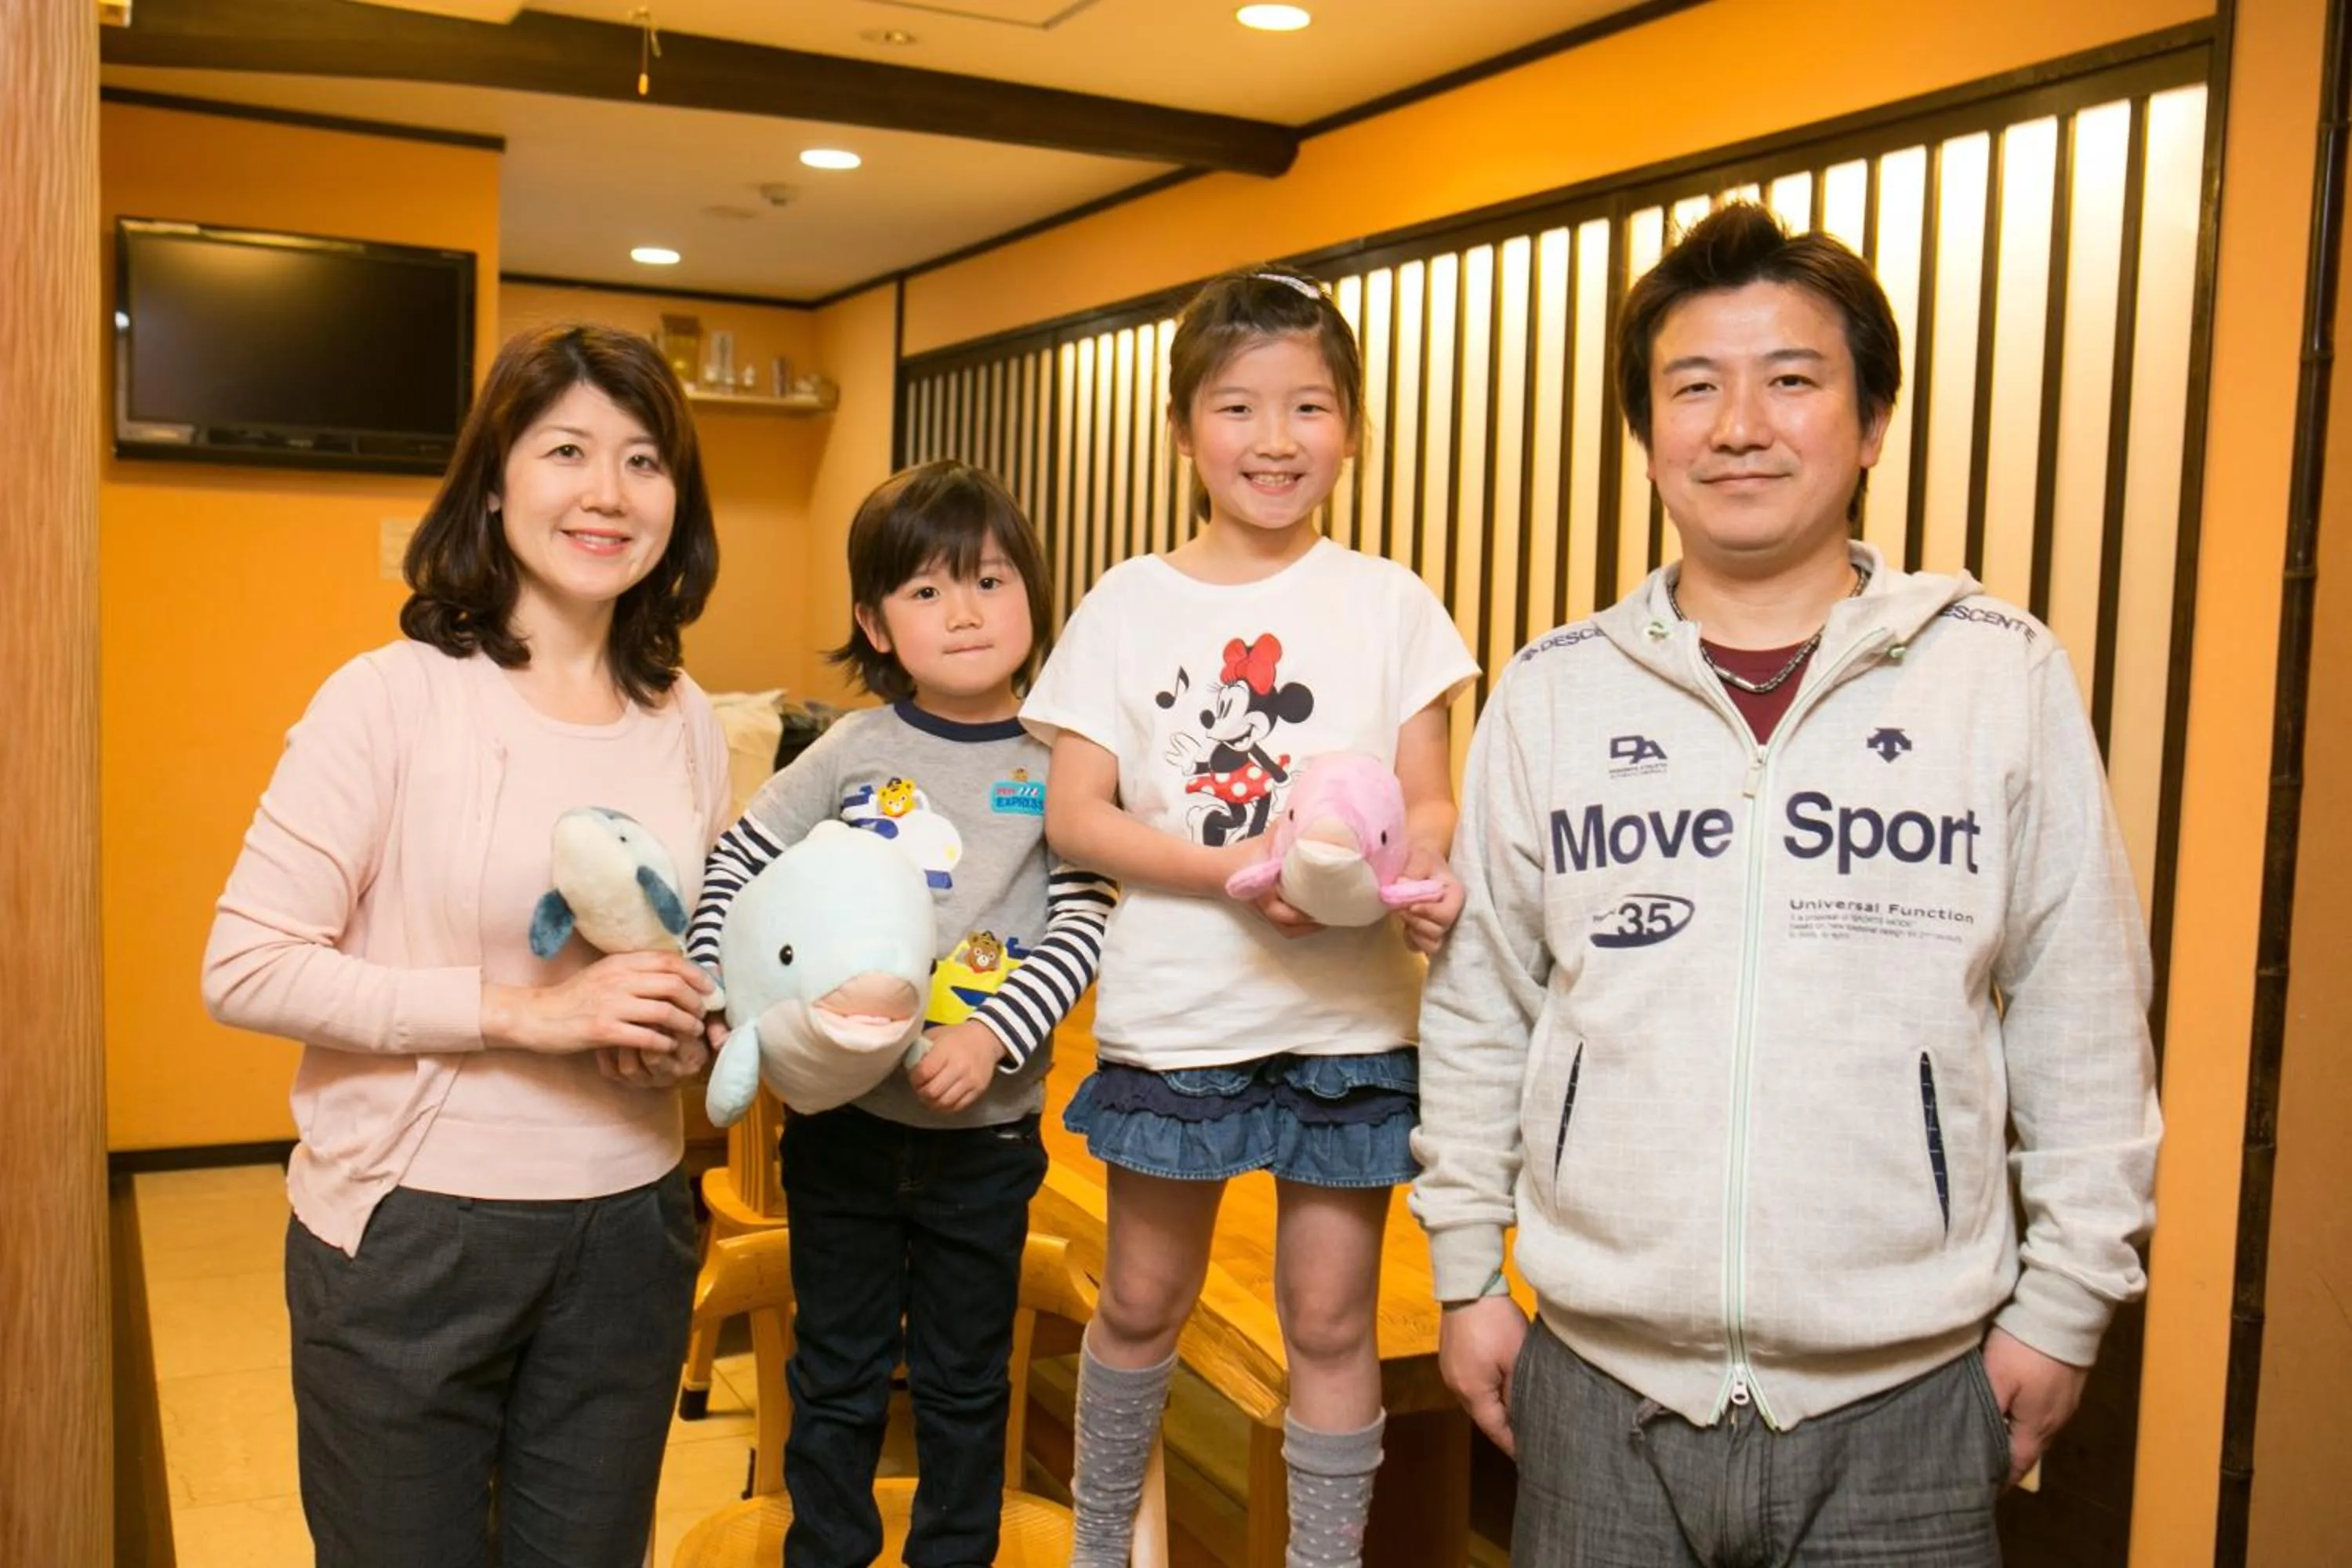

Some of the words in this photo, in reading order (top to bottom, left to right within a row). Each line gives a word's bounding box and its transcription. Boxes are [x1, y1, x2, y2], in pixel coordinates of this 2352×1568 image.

[1550, 804, 1733, 874] Move
[1784, 791, 1980, 875] Sport
[1617, 902, 1673, 938] 35
[1790, 899, 1880, 913] Universal
[1889, 903, 1974, 925] Function
